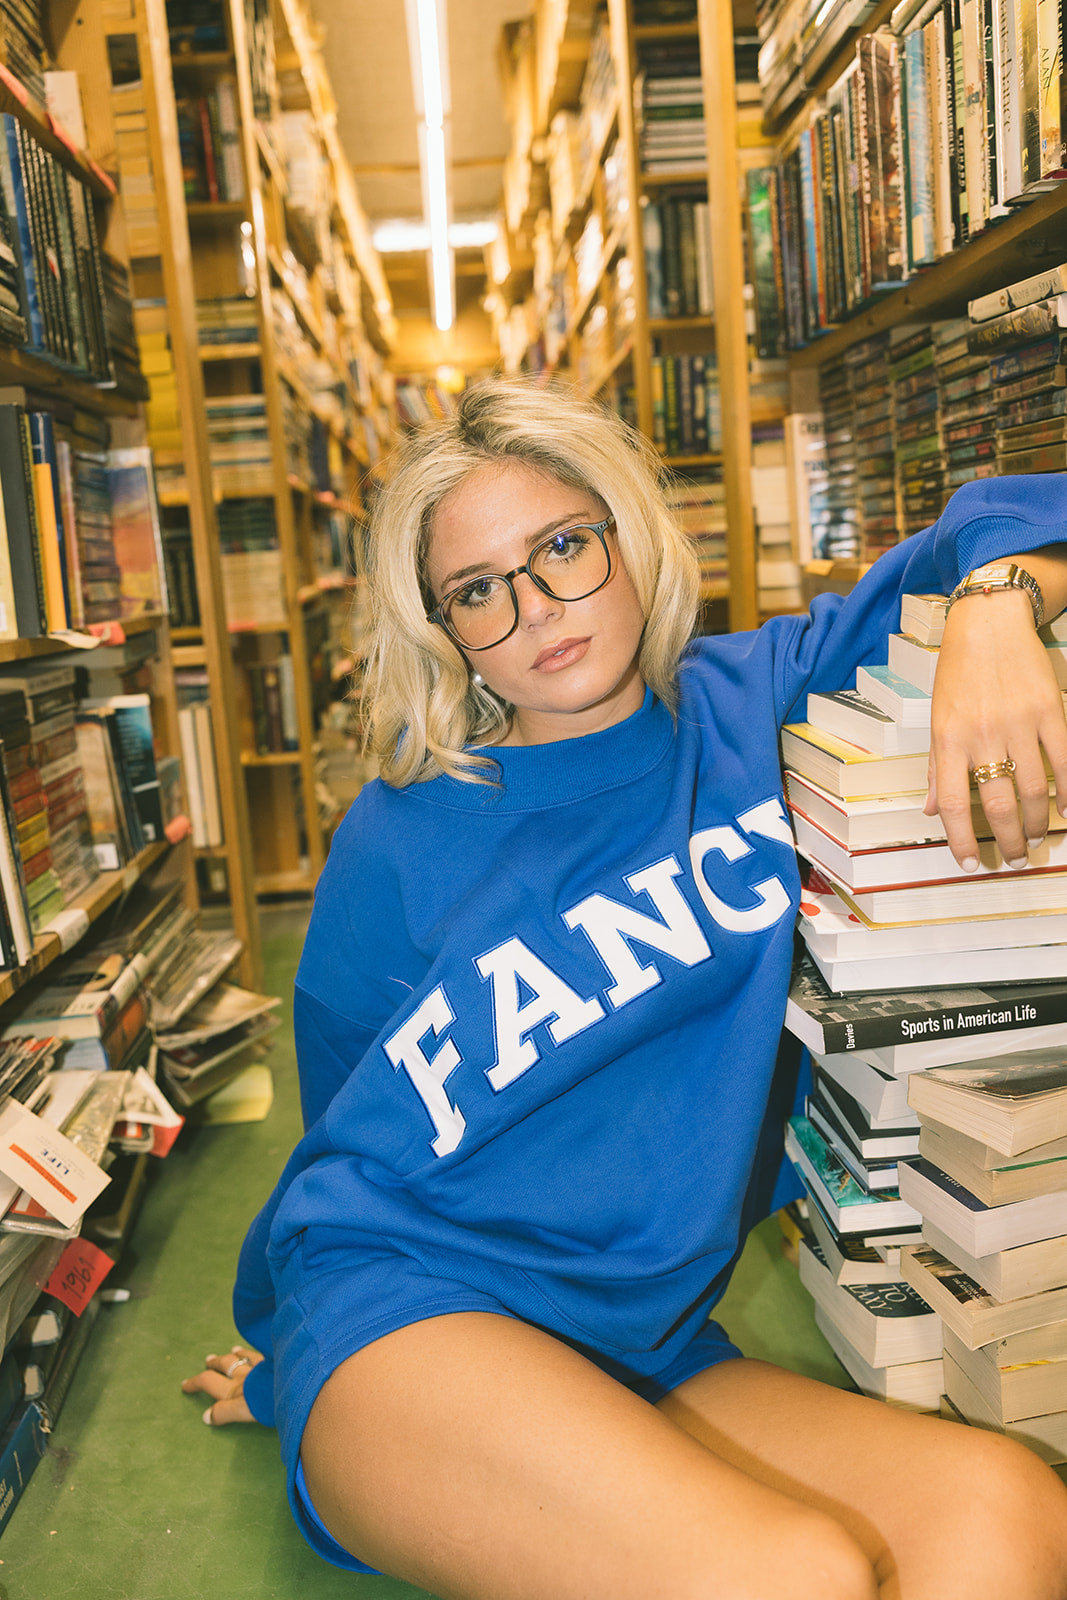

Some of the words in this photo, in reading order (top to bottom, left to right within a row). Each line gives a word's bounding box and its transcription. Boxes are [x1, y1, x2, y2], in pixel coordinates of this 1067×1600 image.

[900, 1018, 941, 1038] Sports
[942, 1014, 955, 1031] in
[957, 1009, 1012, 1029] American
[1015, 1004, 1037, 1021] Life
[845, 1023, 856, 1049] Davies
[42, 1149, 70, 1176] LIFE
[62, 1257, 95, 1301] 1961
[847, 1284, 893, 1311] LAXY
[879, 1285, 908, 1302] TO
